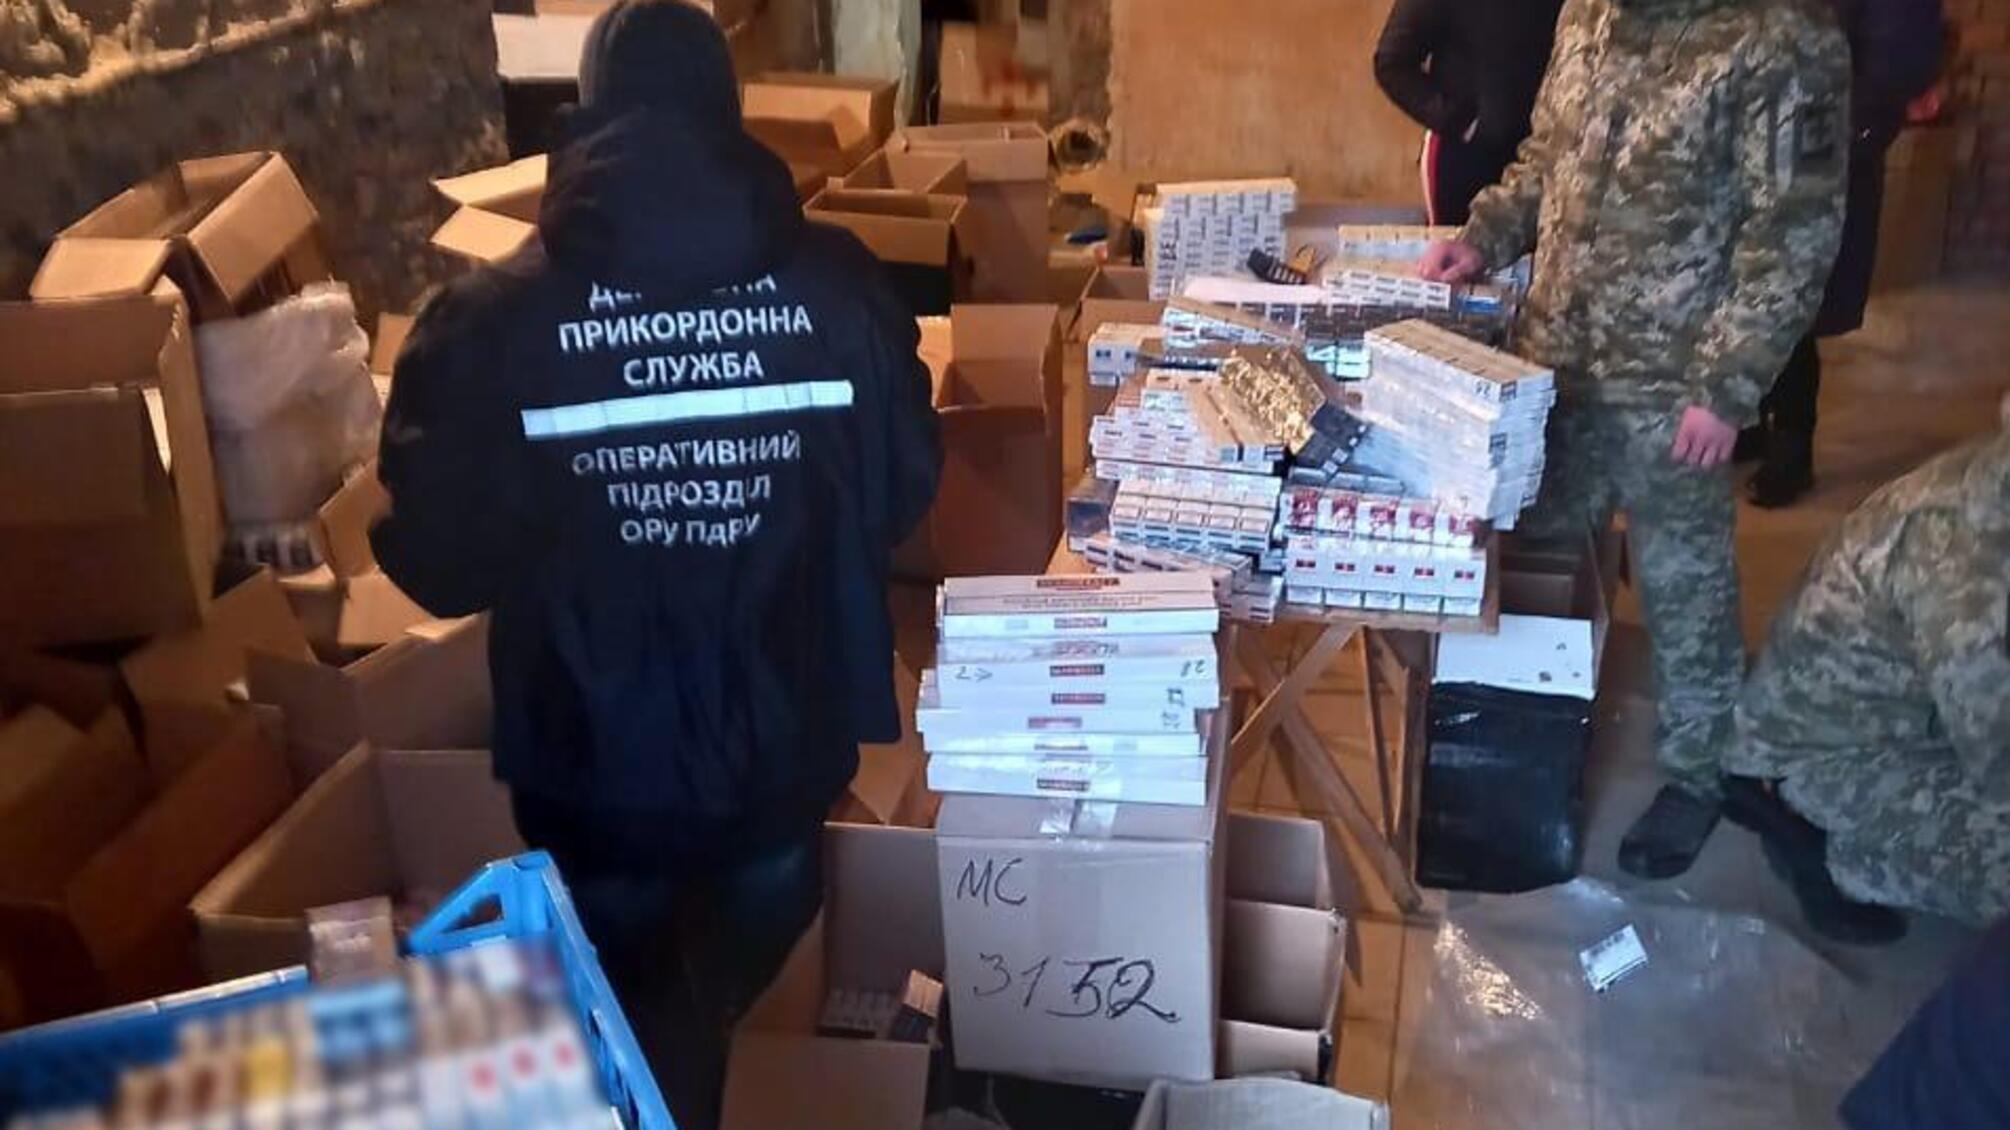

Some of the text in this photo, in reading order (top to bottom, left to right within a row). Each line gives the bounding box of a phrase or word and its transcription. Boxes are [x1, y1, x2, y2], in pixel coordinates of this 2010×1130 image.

[557, 304, 813, 352] ПРИКОРДОННА
[623, 350, 764, 388] СЛУЖБА
[572, 429, 801, 476] ОПЕРАТИВНИЙ
